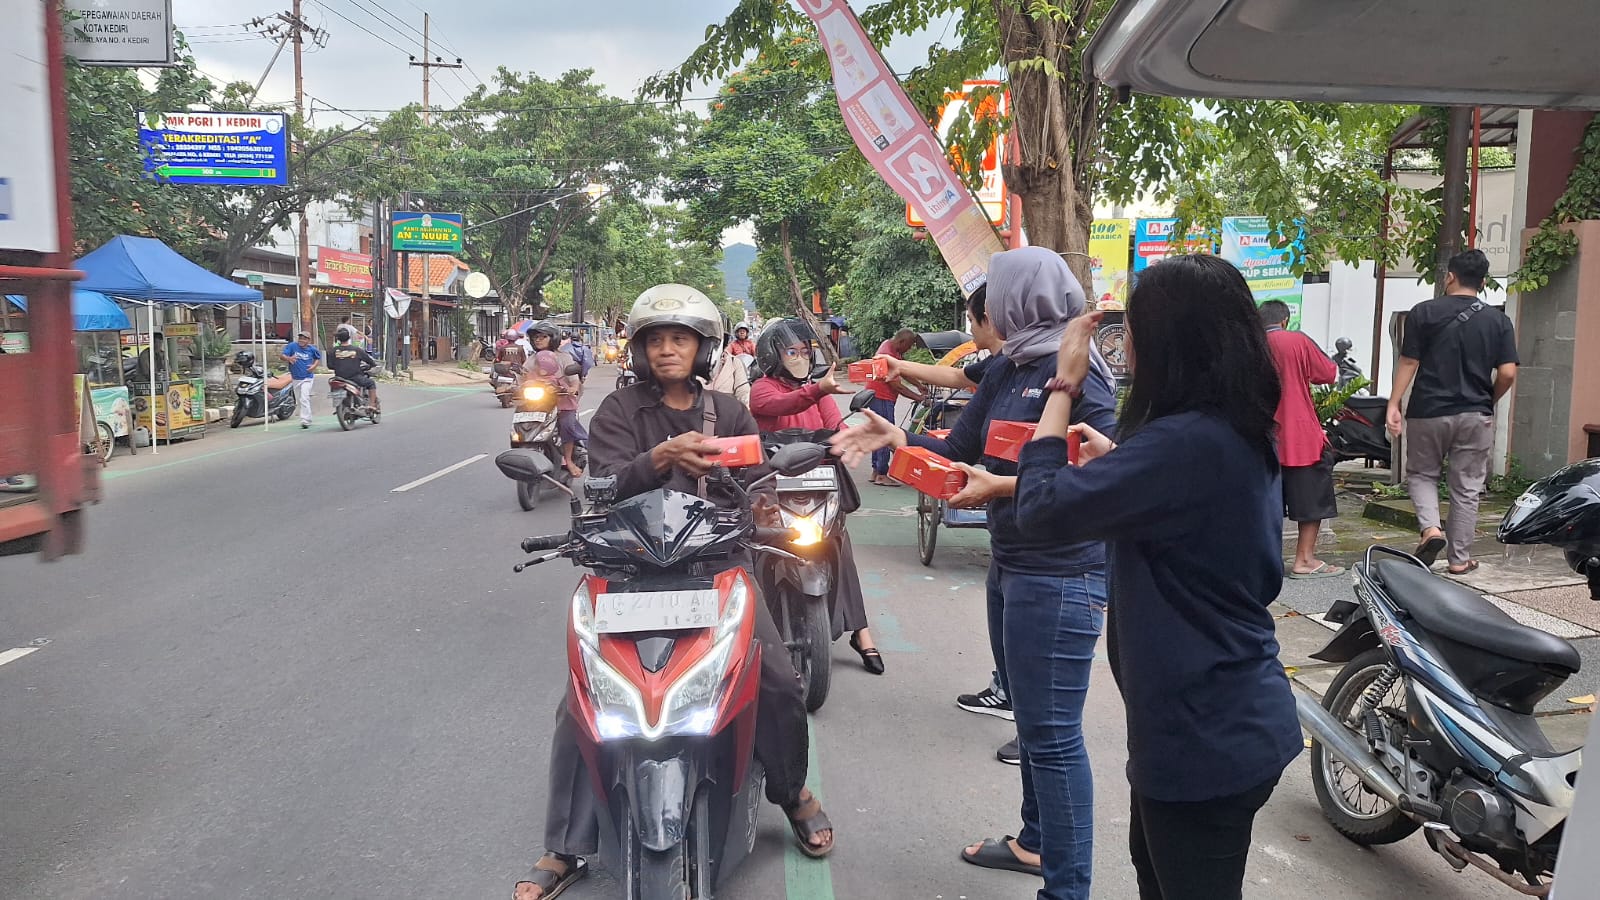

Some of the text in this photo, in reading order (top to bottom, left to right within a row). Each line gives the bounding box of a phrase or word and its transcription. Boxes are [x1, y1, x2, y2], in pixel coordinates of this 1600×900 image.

[80, 10, 162, 20] EPEGAWAIAN DAERAH
[83, 24, 128, 33] KOTA KEDIRI
[188, 117, 213, 127] PGRI
[217, 118, 222, 128] 1
[226, 118, 261, 128] KEDIRI
[162, 133, 240, 144] TERAKREDITASI
[421, 232, 449, 241] NUUR
[1240, 266, 1290, 278] DUP SEHA
